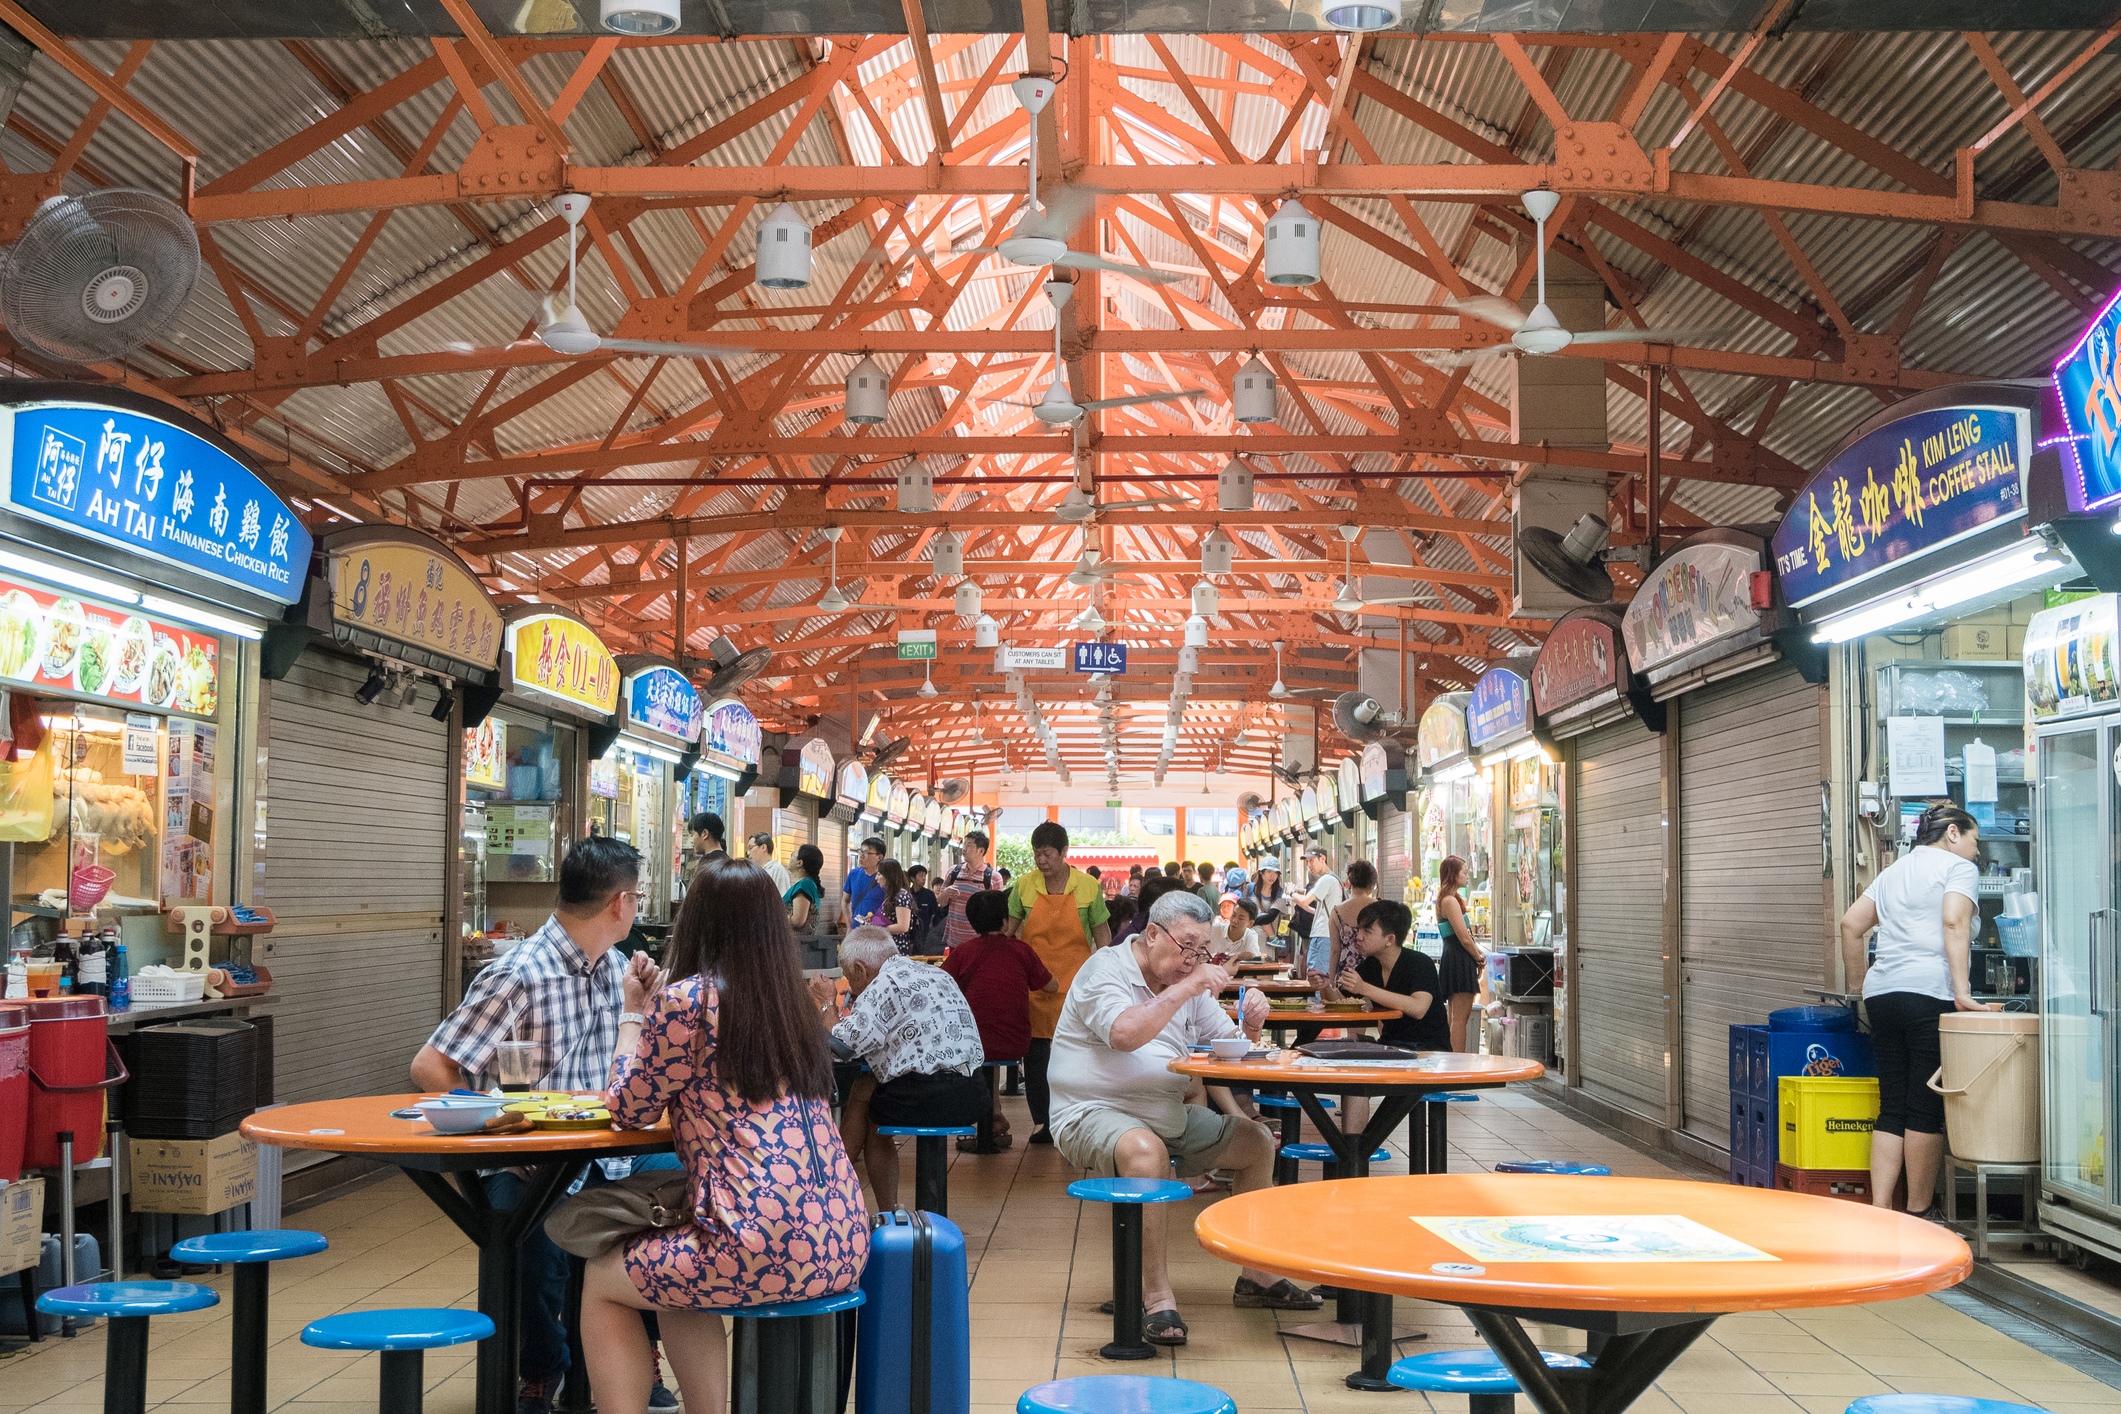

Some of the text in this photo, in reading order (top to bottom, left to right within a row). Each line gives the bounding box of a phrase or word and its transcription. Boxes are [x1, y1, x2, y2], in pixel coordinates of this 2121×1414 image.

[1923, 413, 1981, 469] KIM LENG
[41, 472, 51, 484] AH
[1928, 442, 2016, 506] COFFEE STALL
[47, 486, 57, 499] TAI
[1808, 437, 1926, 576] 金龍咖啡
[85, 488, 290, 585] AH TAI HAINANESE CHICKEN RICE
[1777, 546, 1808, 578] IT'S TIME.
[353, 558, 370, 619] 8
[906, 644, 929, 657] EXIT
[1007, 650, 1042, 659] CUSTOMERS
[1043, 651, 1055, 659] CAN
[1976, 643, 1990, 651] Tiger
[1035, 658, 1055, 666] TABLES
[1805, 1056, 1842, 1077] Tiger
[1828, 1120, 1874, 1132] Heineken
[152, 1171, 202, 1189] DASANI
